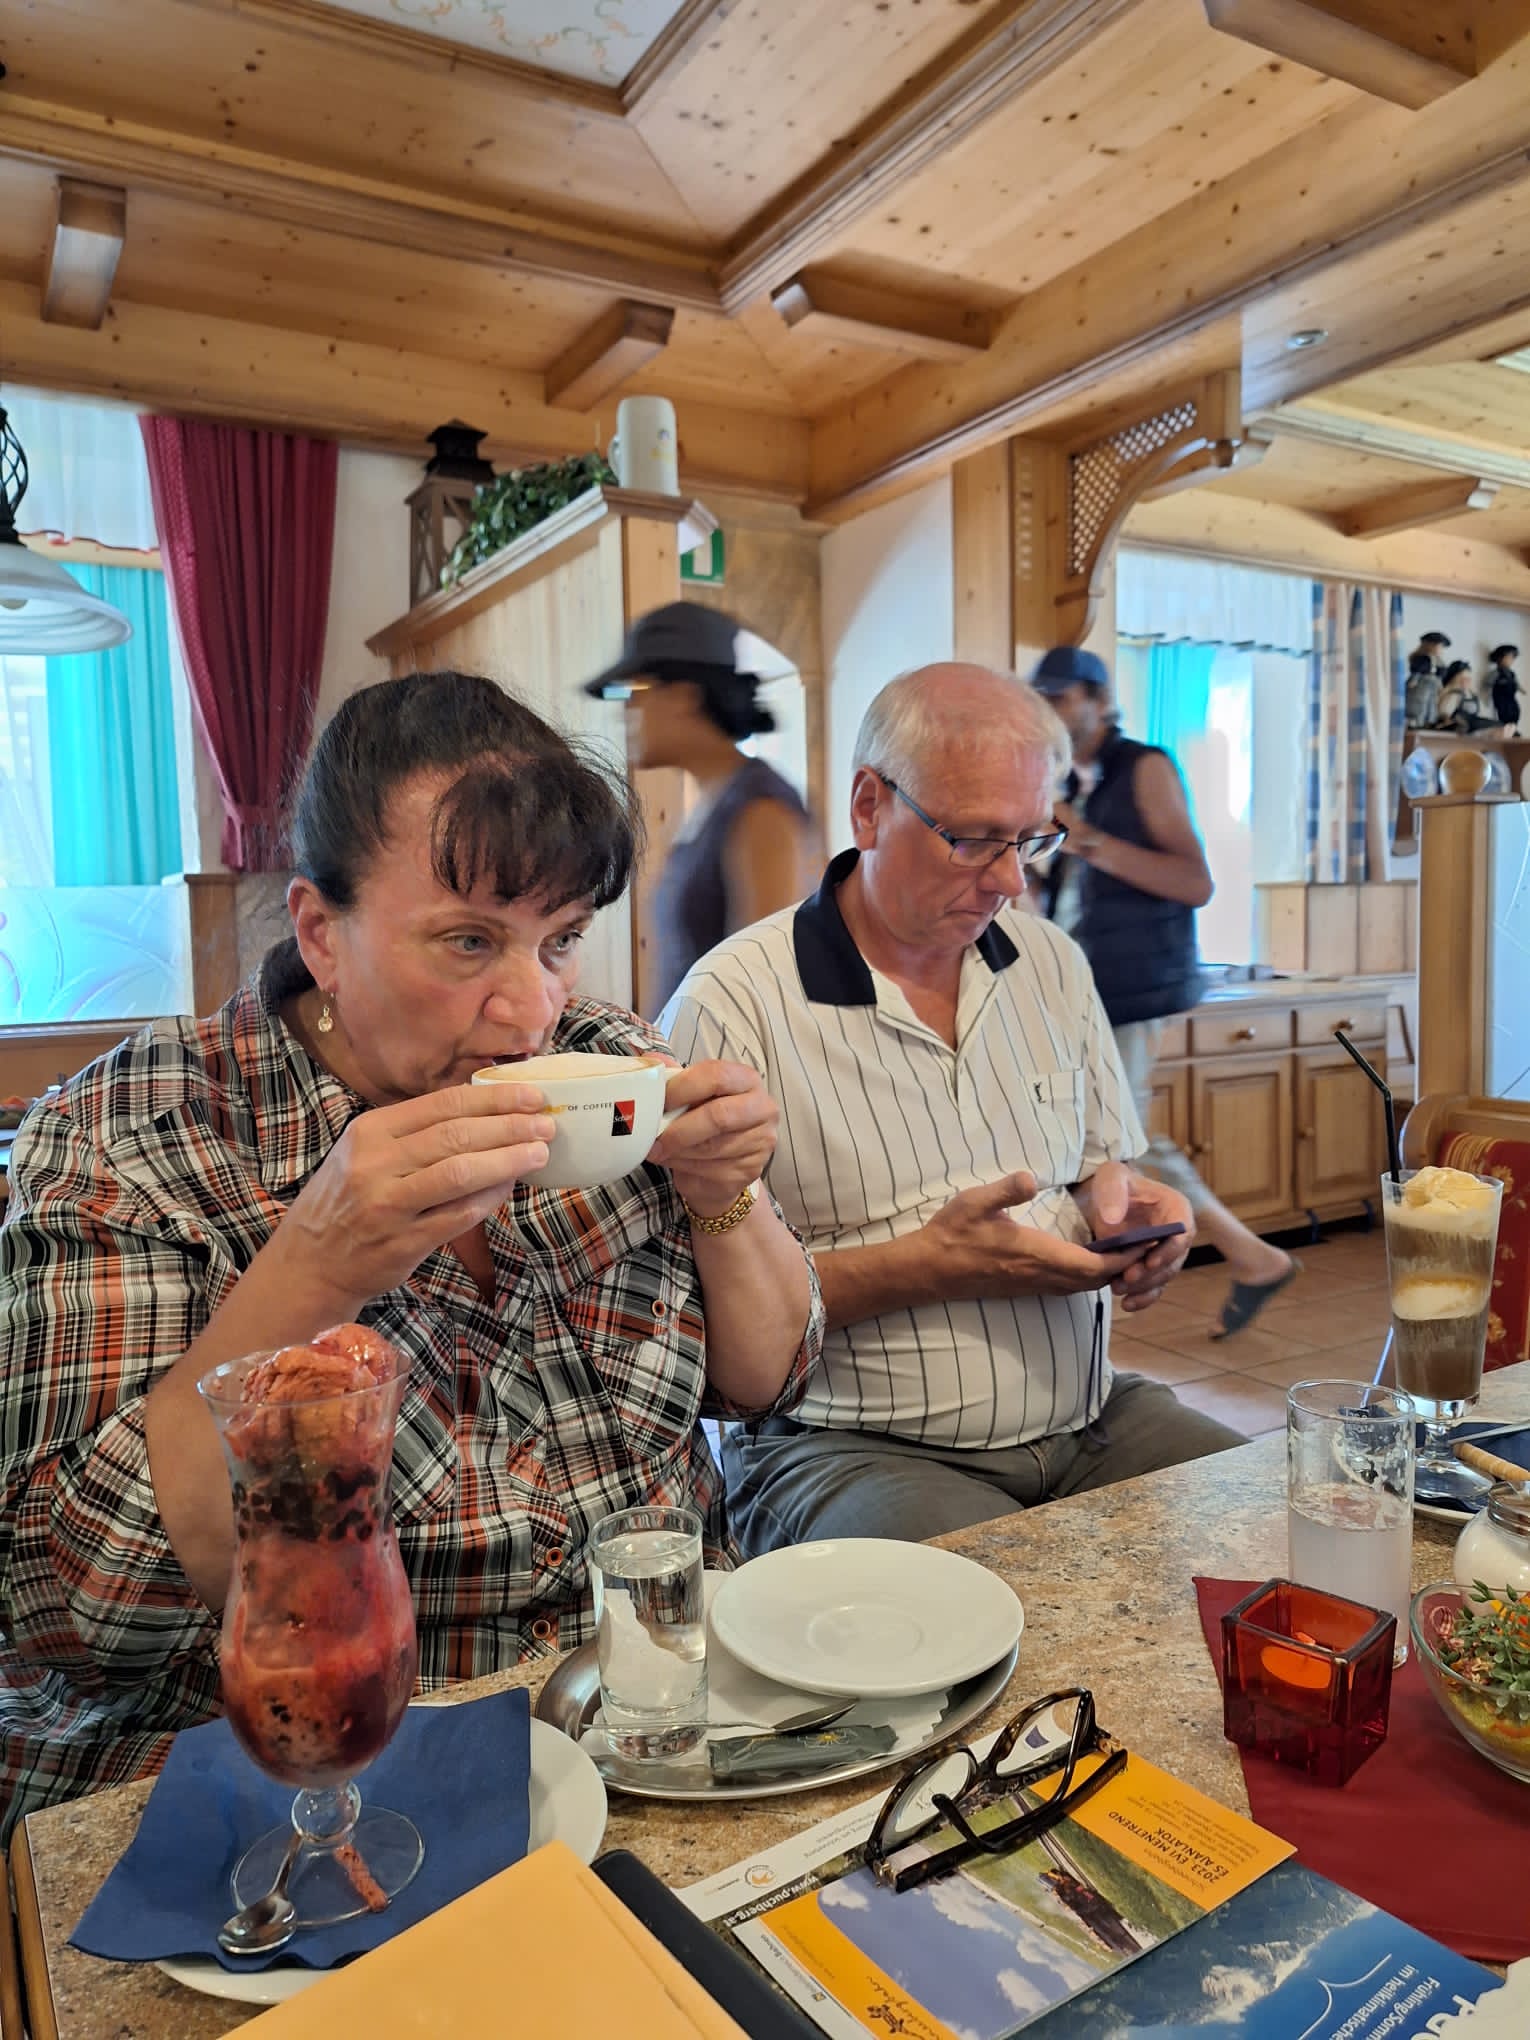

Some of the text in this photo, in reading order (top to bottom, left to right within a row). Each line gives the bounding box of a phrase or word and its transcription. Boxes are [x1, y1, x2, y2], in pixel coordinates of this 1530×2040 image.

[1108, 1810, 1171, 1853] MENETREND
[723, 1874, 819, 1927] www.puchberg.at
[1329, 1964, 1419, 2040] im heilklimatische
